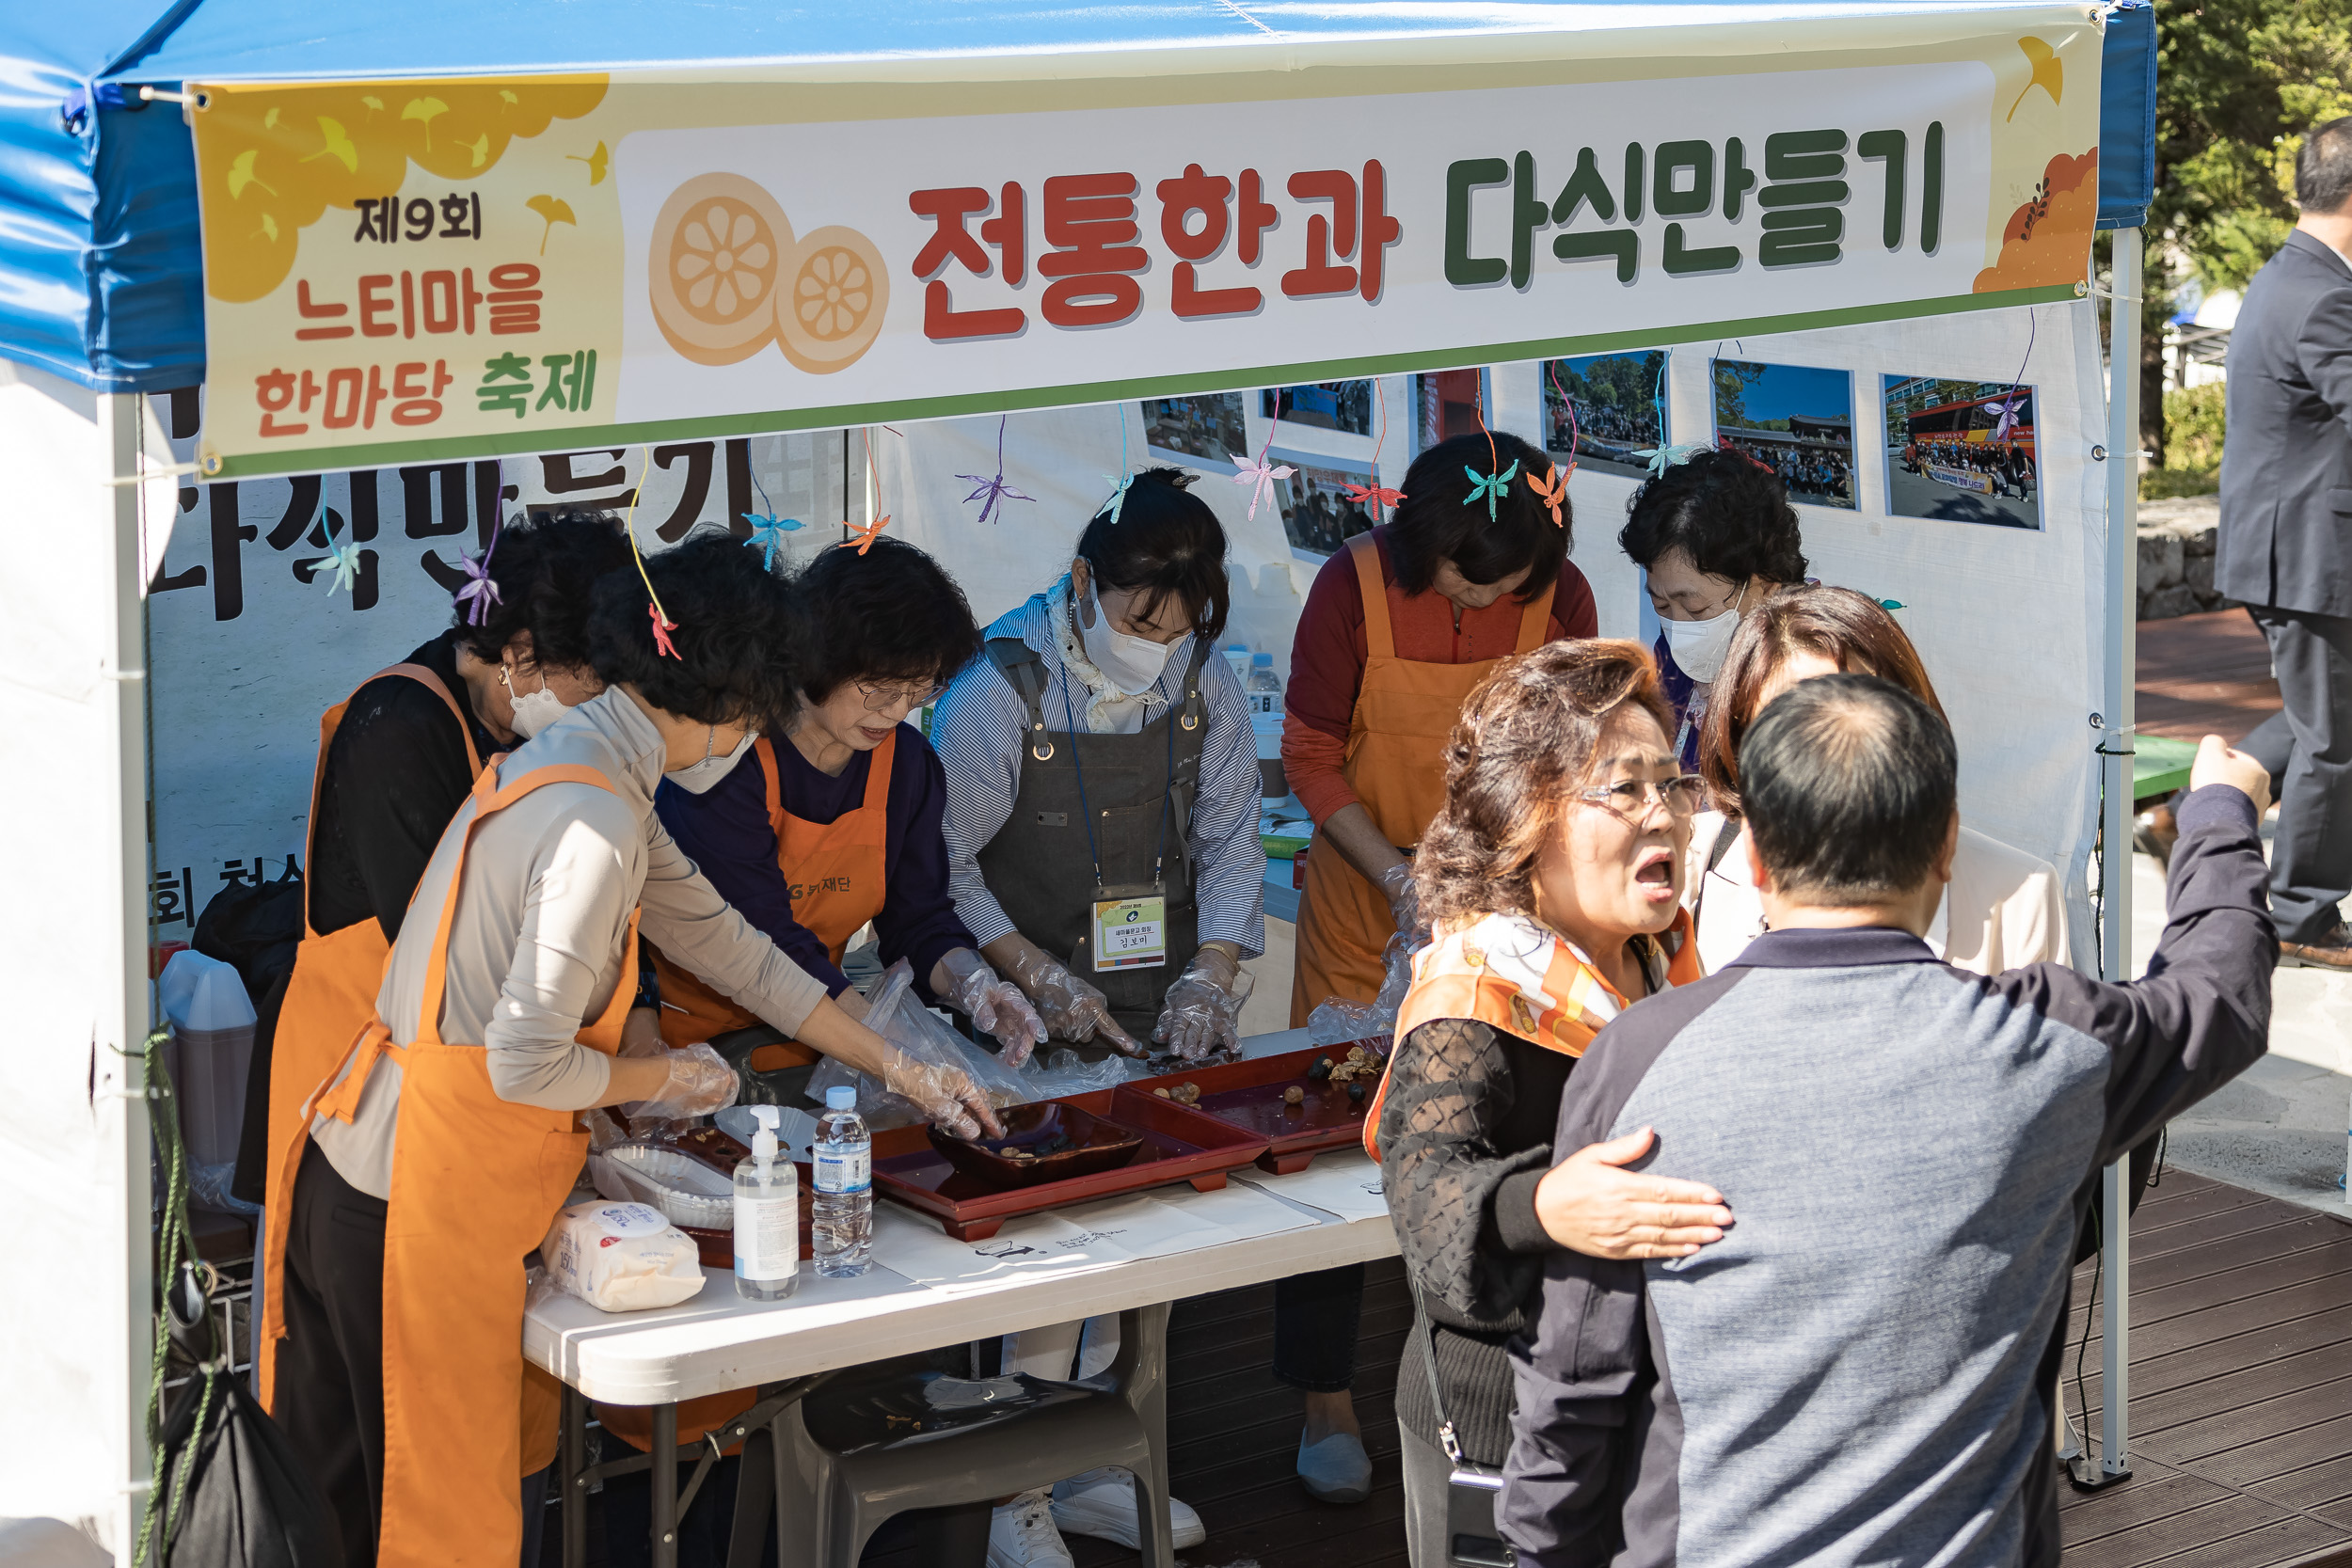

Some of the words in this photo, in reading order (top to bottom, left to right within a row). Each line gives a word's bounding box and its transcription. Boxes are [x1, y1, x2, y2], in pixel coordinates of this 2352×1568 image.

[354, 191, 482, 245] 제9회
[908, 158, 1402, 342] 전통한과
[1443, 120, 1944, 292] 다식만들기
[294, 262, 544, 341] 느티마을
[255, 358, 454, 438] 한마당
[475, 348, 598, 420] 축제
[1115, 927, 1140, 936] 새마을문고
